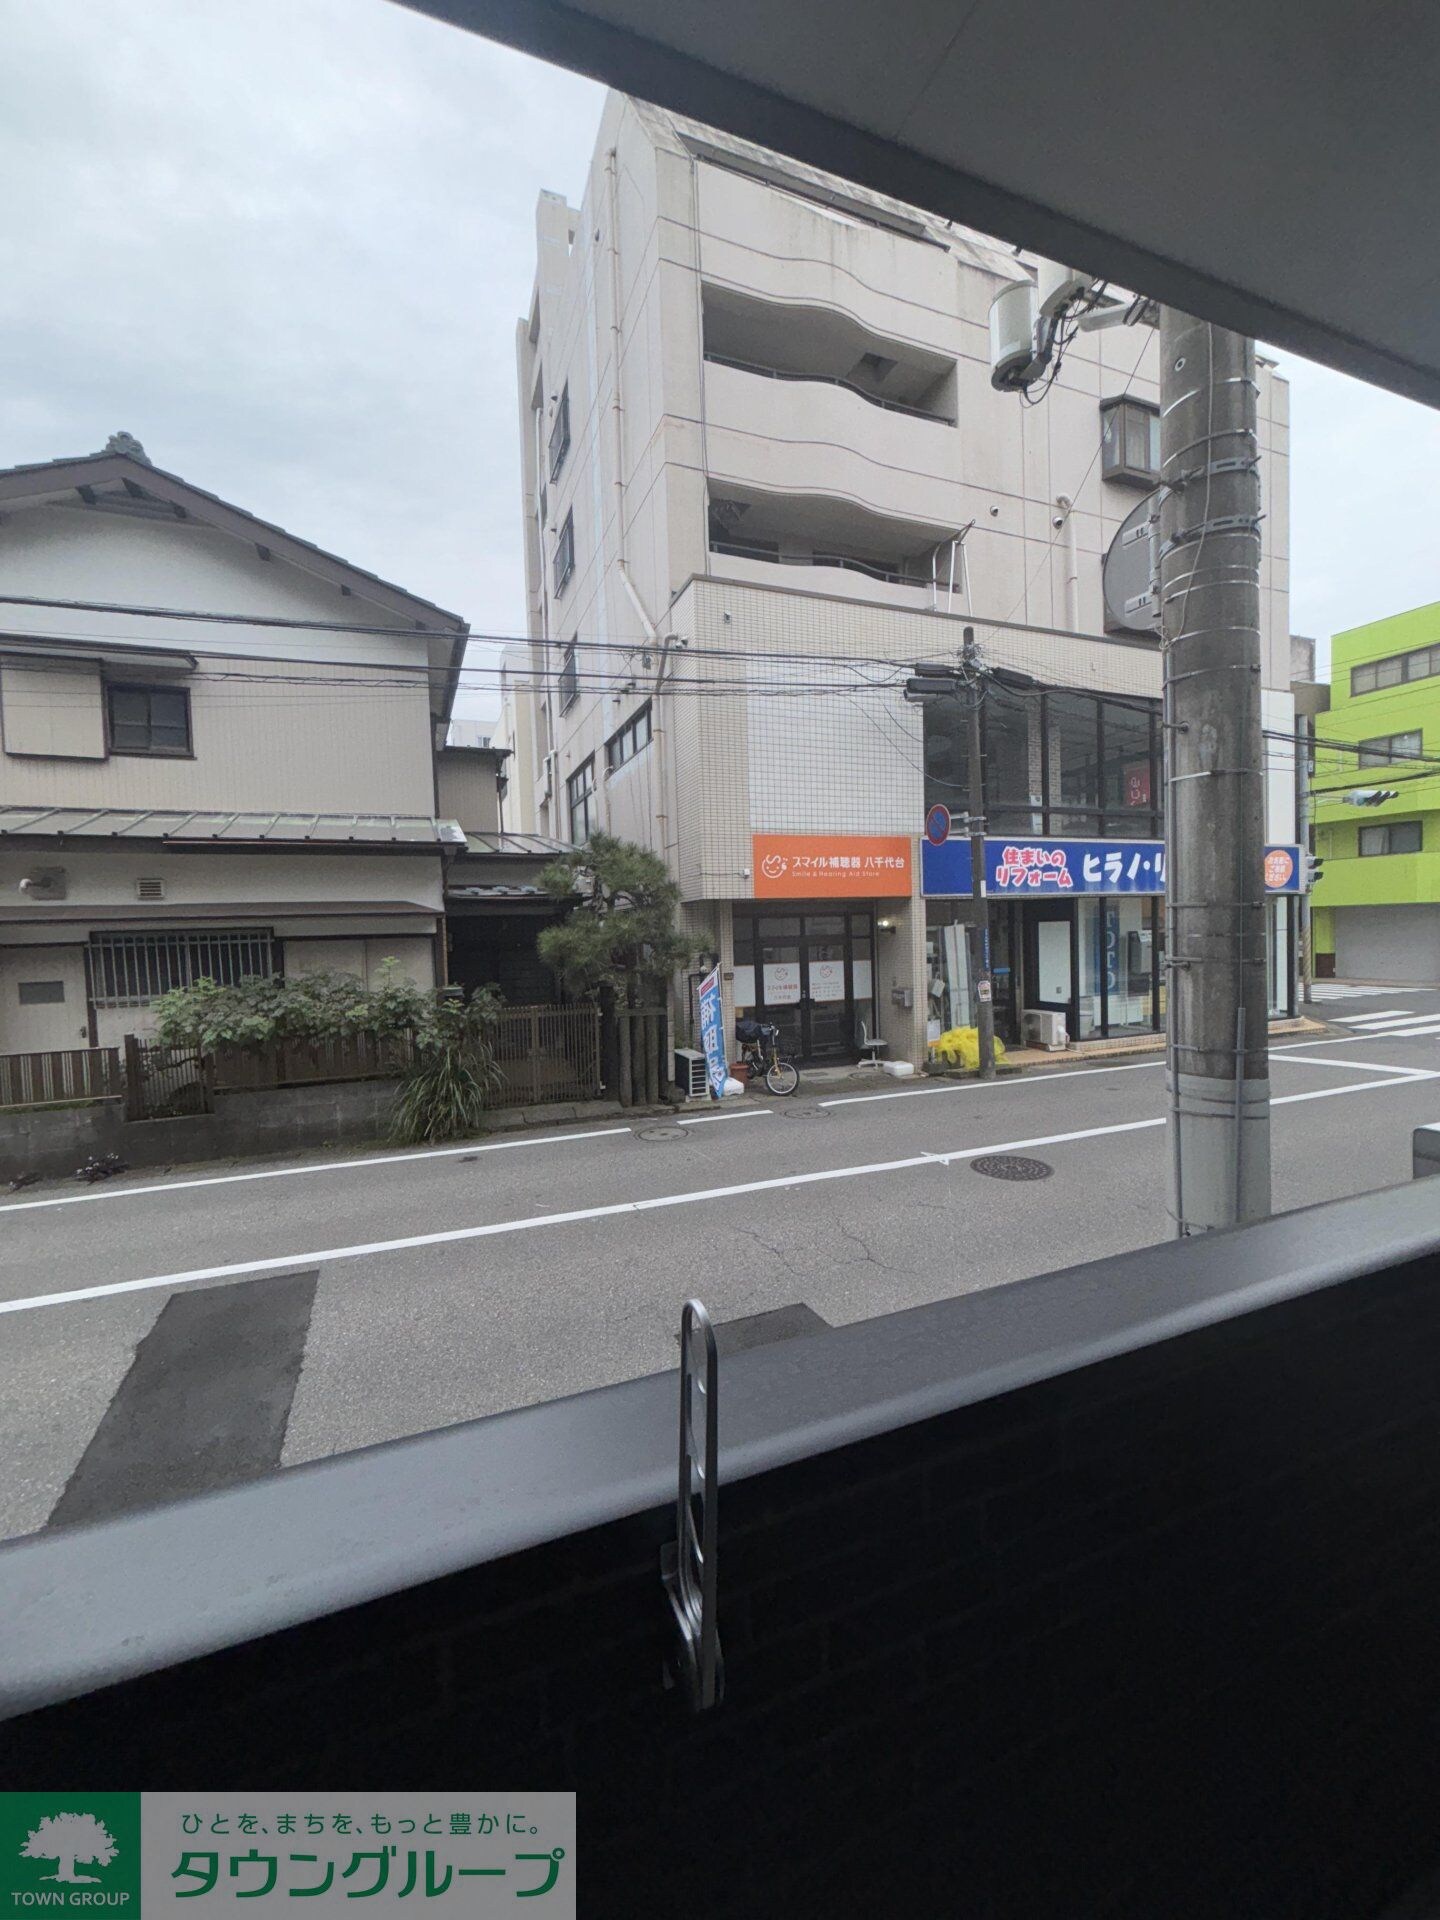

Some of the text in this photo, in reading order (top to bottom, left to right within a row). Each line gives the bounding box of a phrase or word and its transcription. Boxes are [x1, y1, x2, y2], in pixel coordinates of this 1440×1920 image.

[793, 856, 905, 869] スマイル補聴器 八千代台
[1002, 846, 1066, 868] 住まいの
[996, 865, 1073, 888] リフォーム
